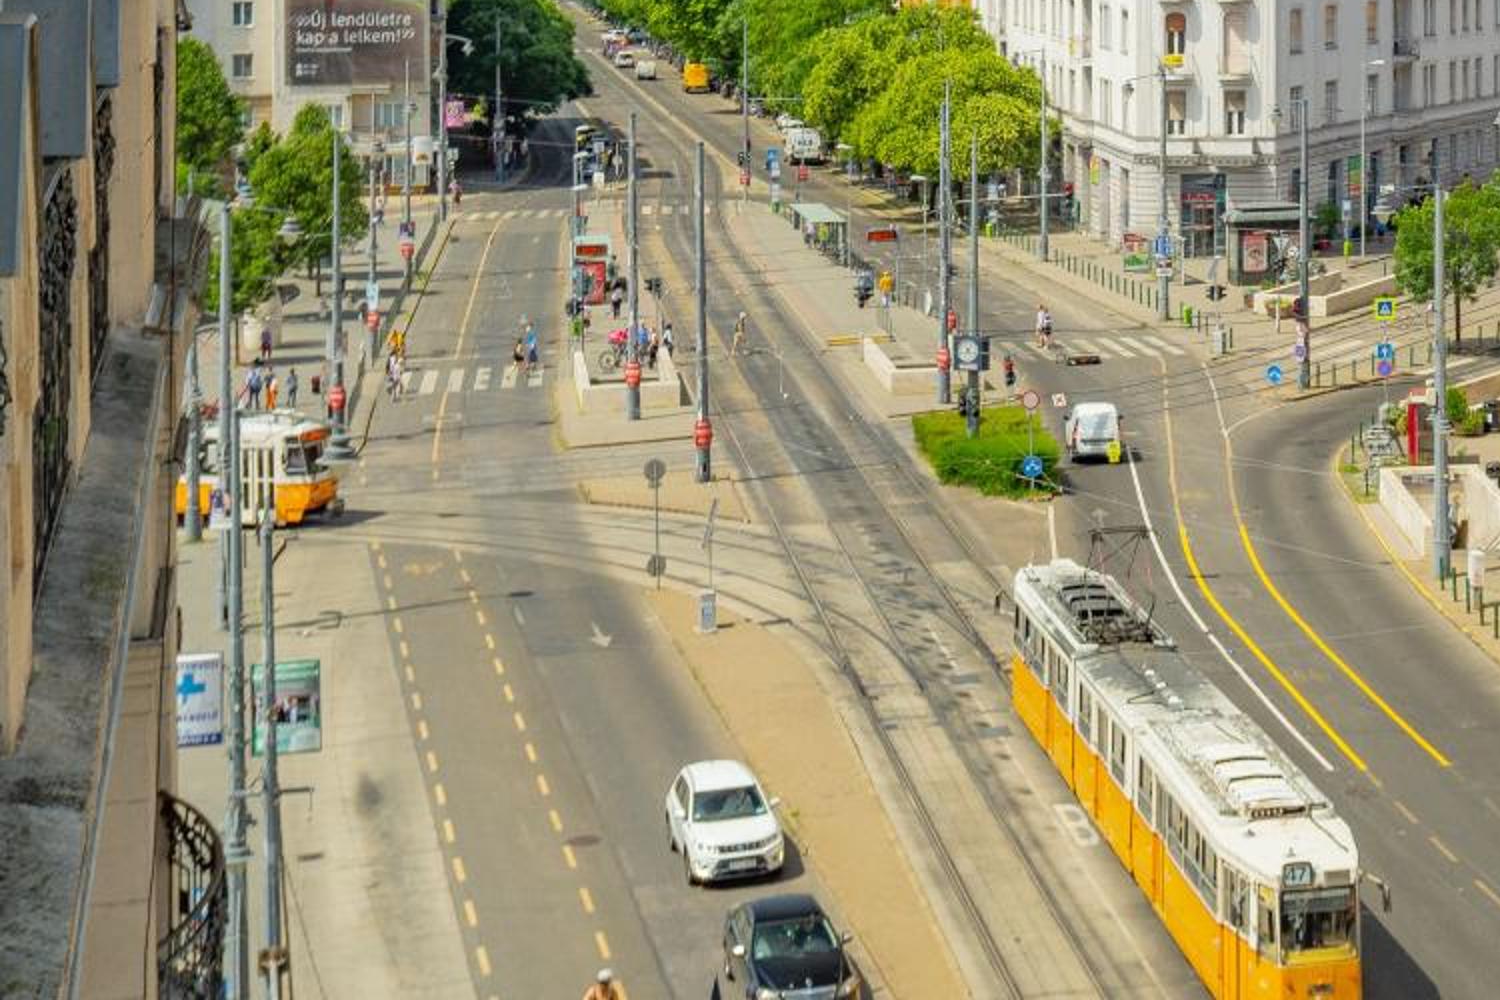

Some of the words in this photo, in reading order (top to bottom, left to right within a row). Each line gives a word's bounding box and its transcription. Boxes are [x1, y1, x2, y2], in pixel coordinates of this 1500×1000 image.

[331, 11, 412, 27] lendületre
[296, 29, 324, 46] kap
[328, 33, 339, 44] a
[1284, 866, 1306, 882] 47
